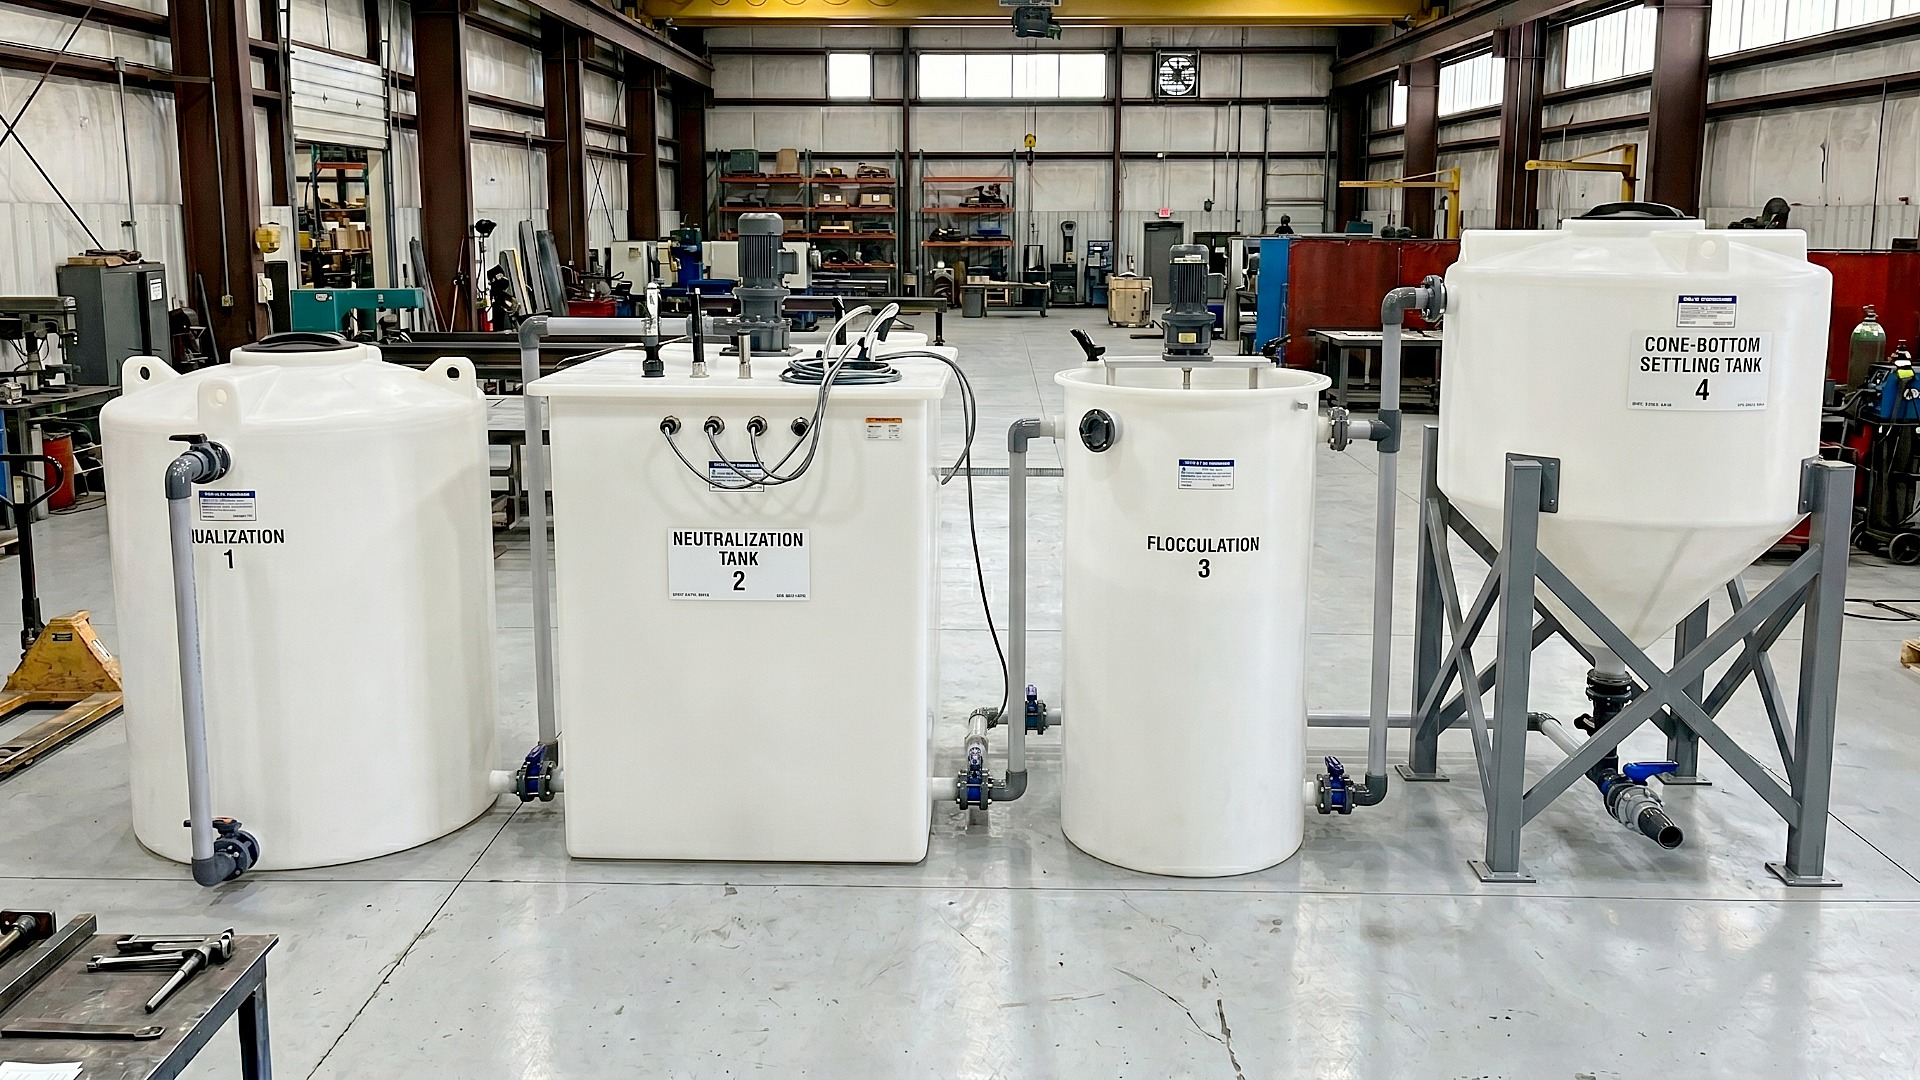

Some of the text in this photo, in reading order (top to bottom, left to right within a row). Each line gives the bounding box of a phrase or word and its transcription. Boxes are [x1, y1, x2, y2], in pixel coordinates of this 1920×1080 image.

[1645, 337, 1760, 353] CONE-BOTTOM
[1640, 356, 1762, 373] SETTLING TANK
[1695, 378, 1710, 401] 4
[192, 529, 284, 544] UALIZATION
[673, 531, 803, 547] NEUTRALIZATION
[1147, 535, 1259, 553] FLOCCULATION
[223, 548, 234, 569] 1
[718, 551, 759, 566] TANK
[1198, 558, 1211, 578] 3
[732, 570, 746, 591] 2
